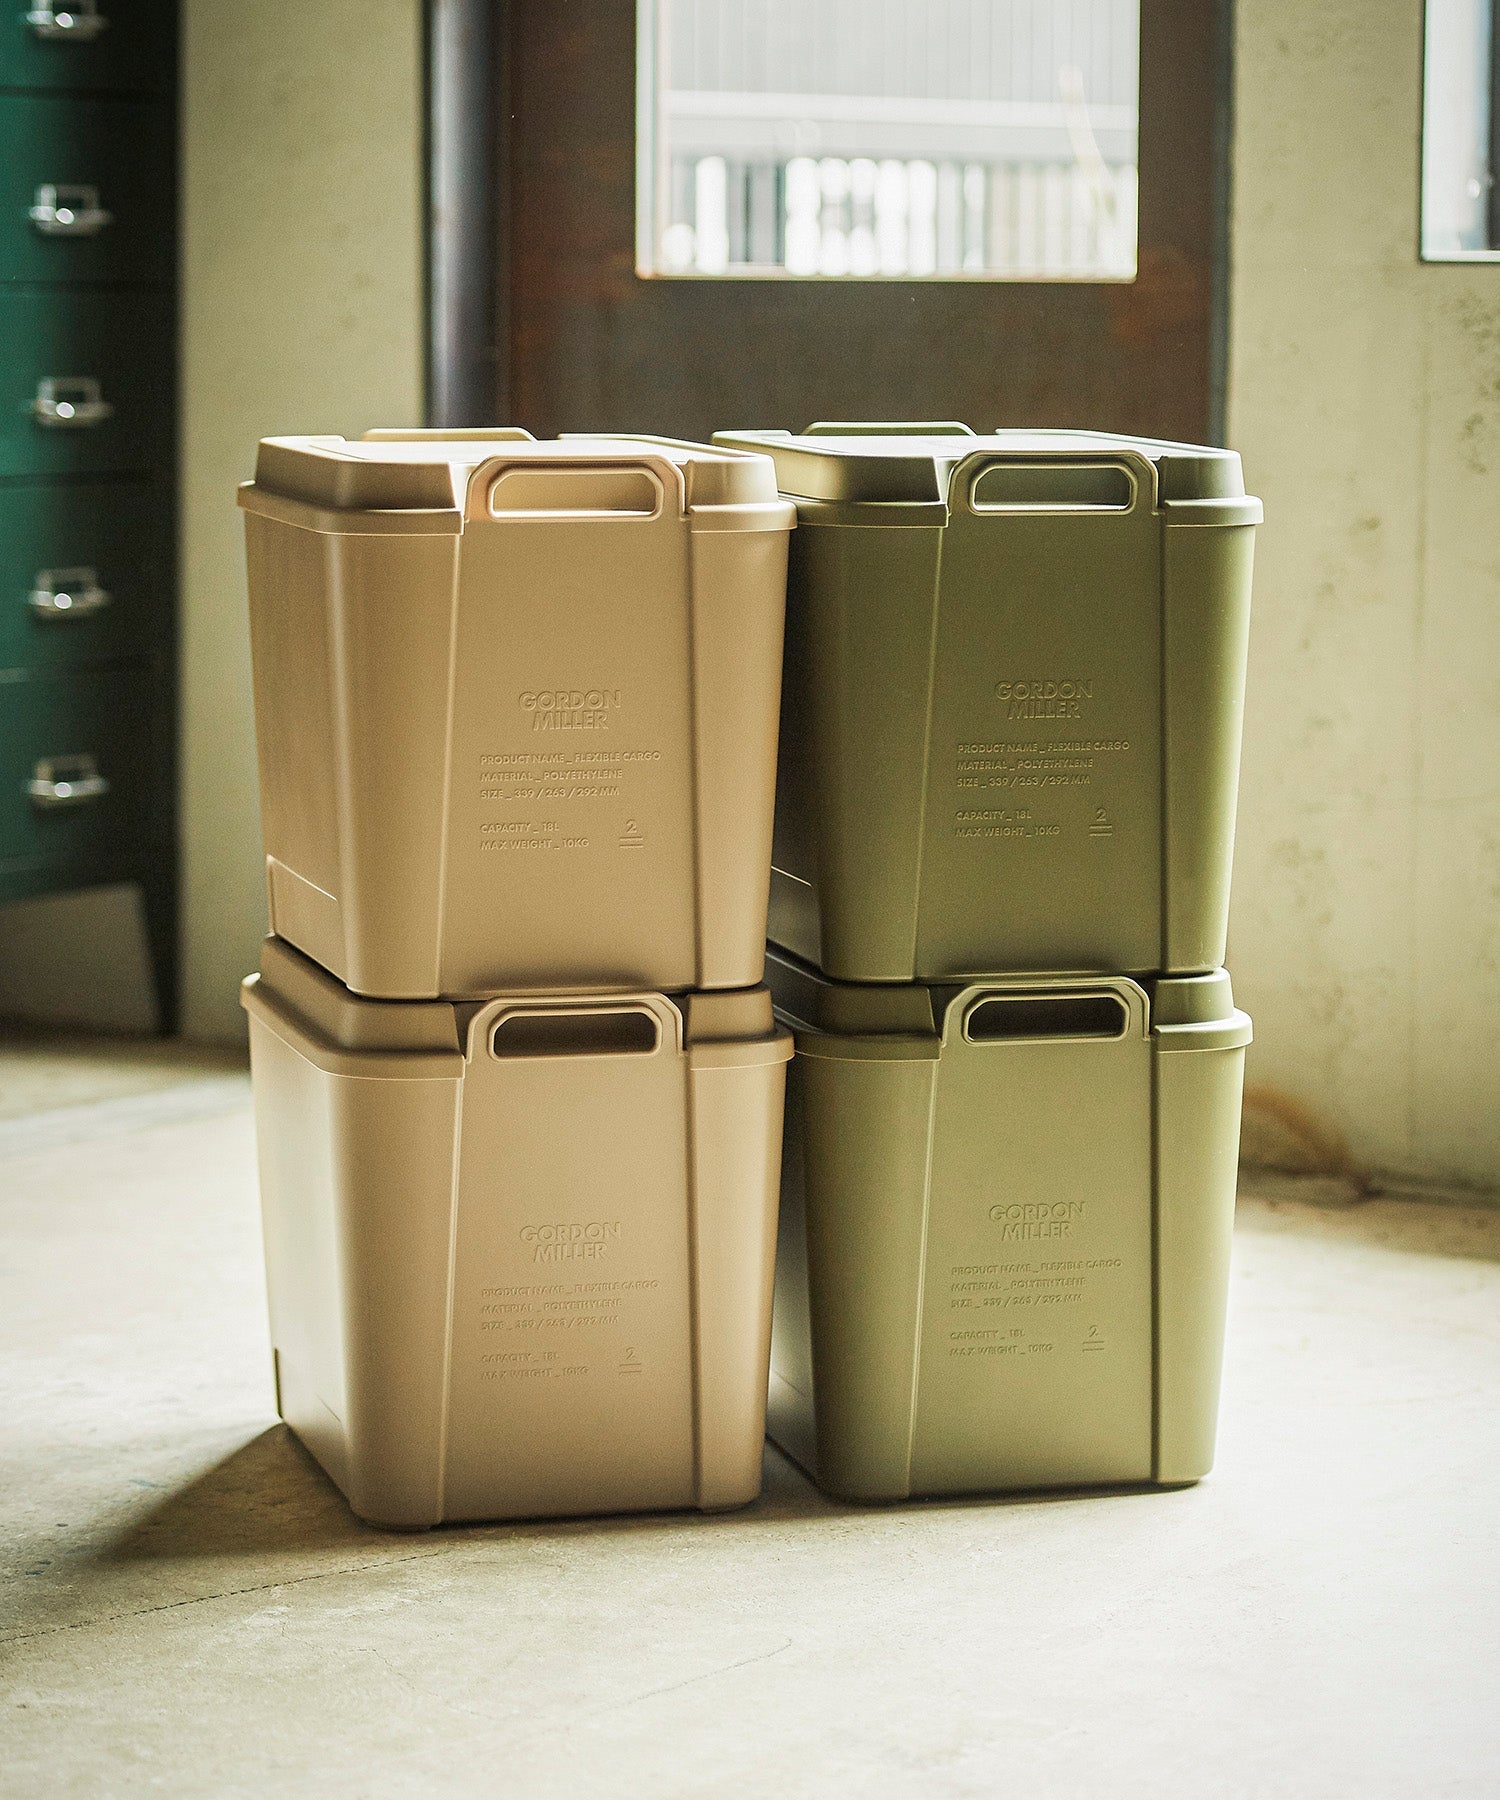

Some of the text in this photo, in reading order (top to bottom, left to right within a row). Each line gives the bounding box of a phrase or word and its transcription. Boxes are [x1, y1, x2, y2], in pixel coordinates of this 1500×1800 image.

[995, 679, 1093, 700] GORDON
[519, 690, 622, 711] GORDON
[1008, 700, 1081, 720] MILLER
[533, 711, 609, 731] MILLER
[958, 744, 1005, 754] PRODUCT
[1047, 742, 1092, 752] FLEXIBLE
[1094, 741, 1130, 751] CARGO
[480, 755, 530, 765] PRODUCT
[575, 753, 621, 762] FLEXIBLE
[623, 752, 661, 762] CARGO
[1017, 759, 1094, 769] POLYETHYLENE
[544, 770, 623, 781] POLYETHYLENE
[989, 777, 1008, 787] 339
[1019, 777, 1038, 786] 263
[1050, 776, 1068, 785] 292
[1070, 776, 1090, 785] MM
[515, 789, 534, 799] 339
[546, 789, 565, 798] 263
[577, 788, 597, 797] 292
[600, 787, 619, 796] MM
[1016, 810, 1032, 819] 18L
[1097, 809, 1106, 822] 2
[543, 822, 559, 832] 18L
[626, 819, 637, 834] 2
[956, 828, 981, 838] MAX
[1034, 826, 1060, 836] 10KG
[480, 841, 508, 850] MAX
[563, 839, 589, 848] 10KG
[989, 1201, 1085, 1221] GORDON
[519, 1222, 621, 1242] GORDON
[1001, 1221, 1074, 1242] MILLER
[533, 1242, 609, 1263] MILLER
[951, 1266, 998, 1275] PRODUCT
[1041, 1261, 1084, 1272] FLEXIBLE
[1086, 1260, 1122, 1269] CARGO
[482, 1287, 530, 1298] PRODUCT
[575, 1283, 619, 1293] FLEXIBLE
[622, 1280, 660, 1290] CARGO
[1011, 1278, 1086, 1289] POLYETHYLENE
[544, 1299, 622, 1311] POLYETHYLENE
[1064, 1294, 1082, 1303] MM
[600, 1316, 619, 1325] MM
[1089, 1325, 1099, 1338] 2
[625, 1347, 636, 1360] 2
[950, 1347, 975, 1357] MAX
[1028, 1344, 1053, 1354] 10KG
[481, 1370, 508, 1380] MAX
[563, 1367, 589, 1376] 10KG
